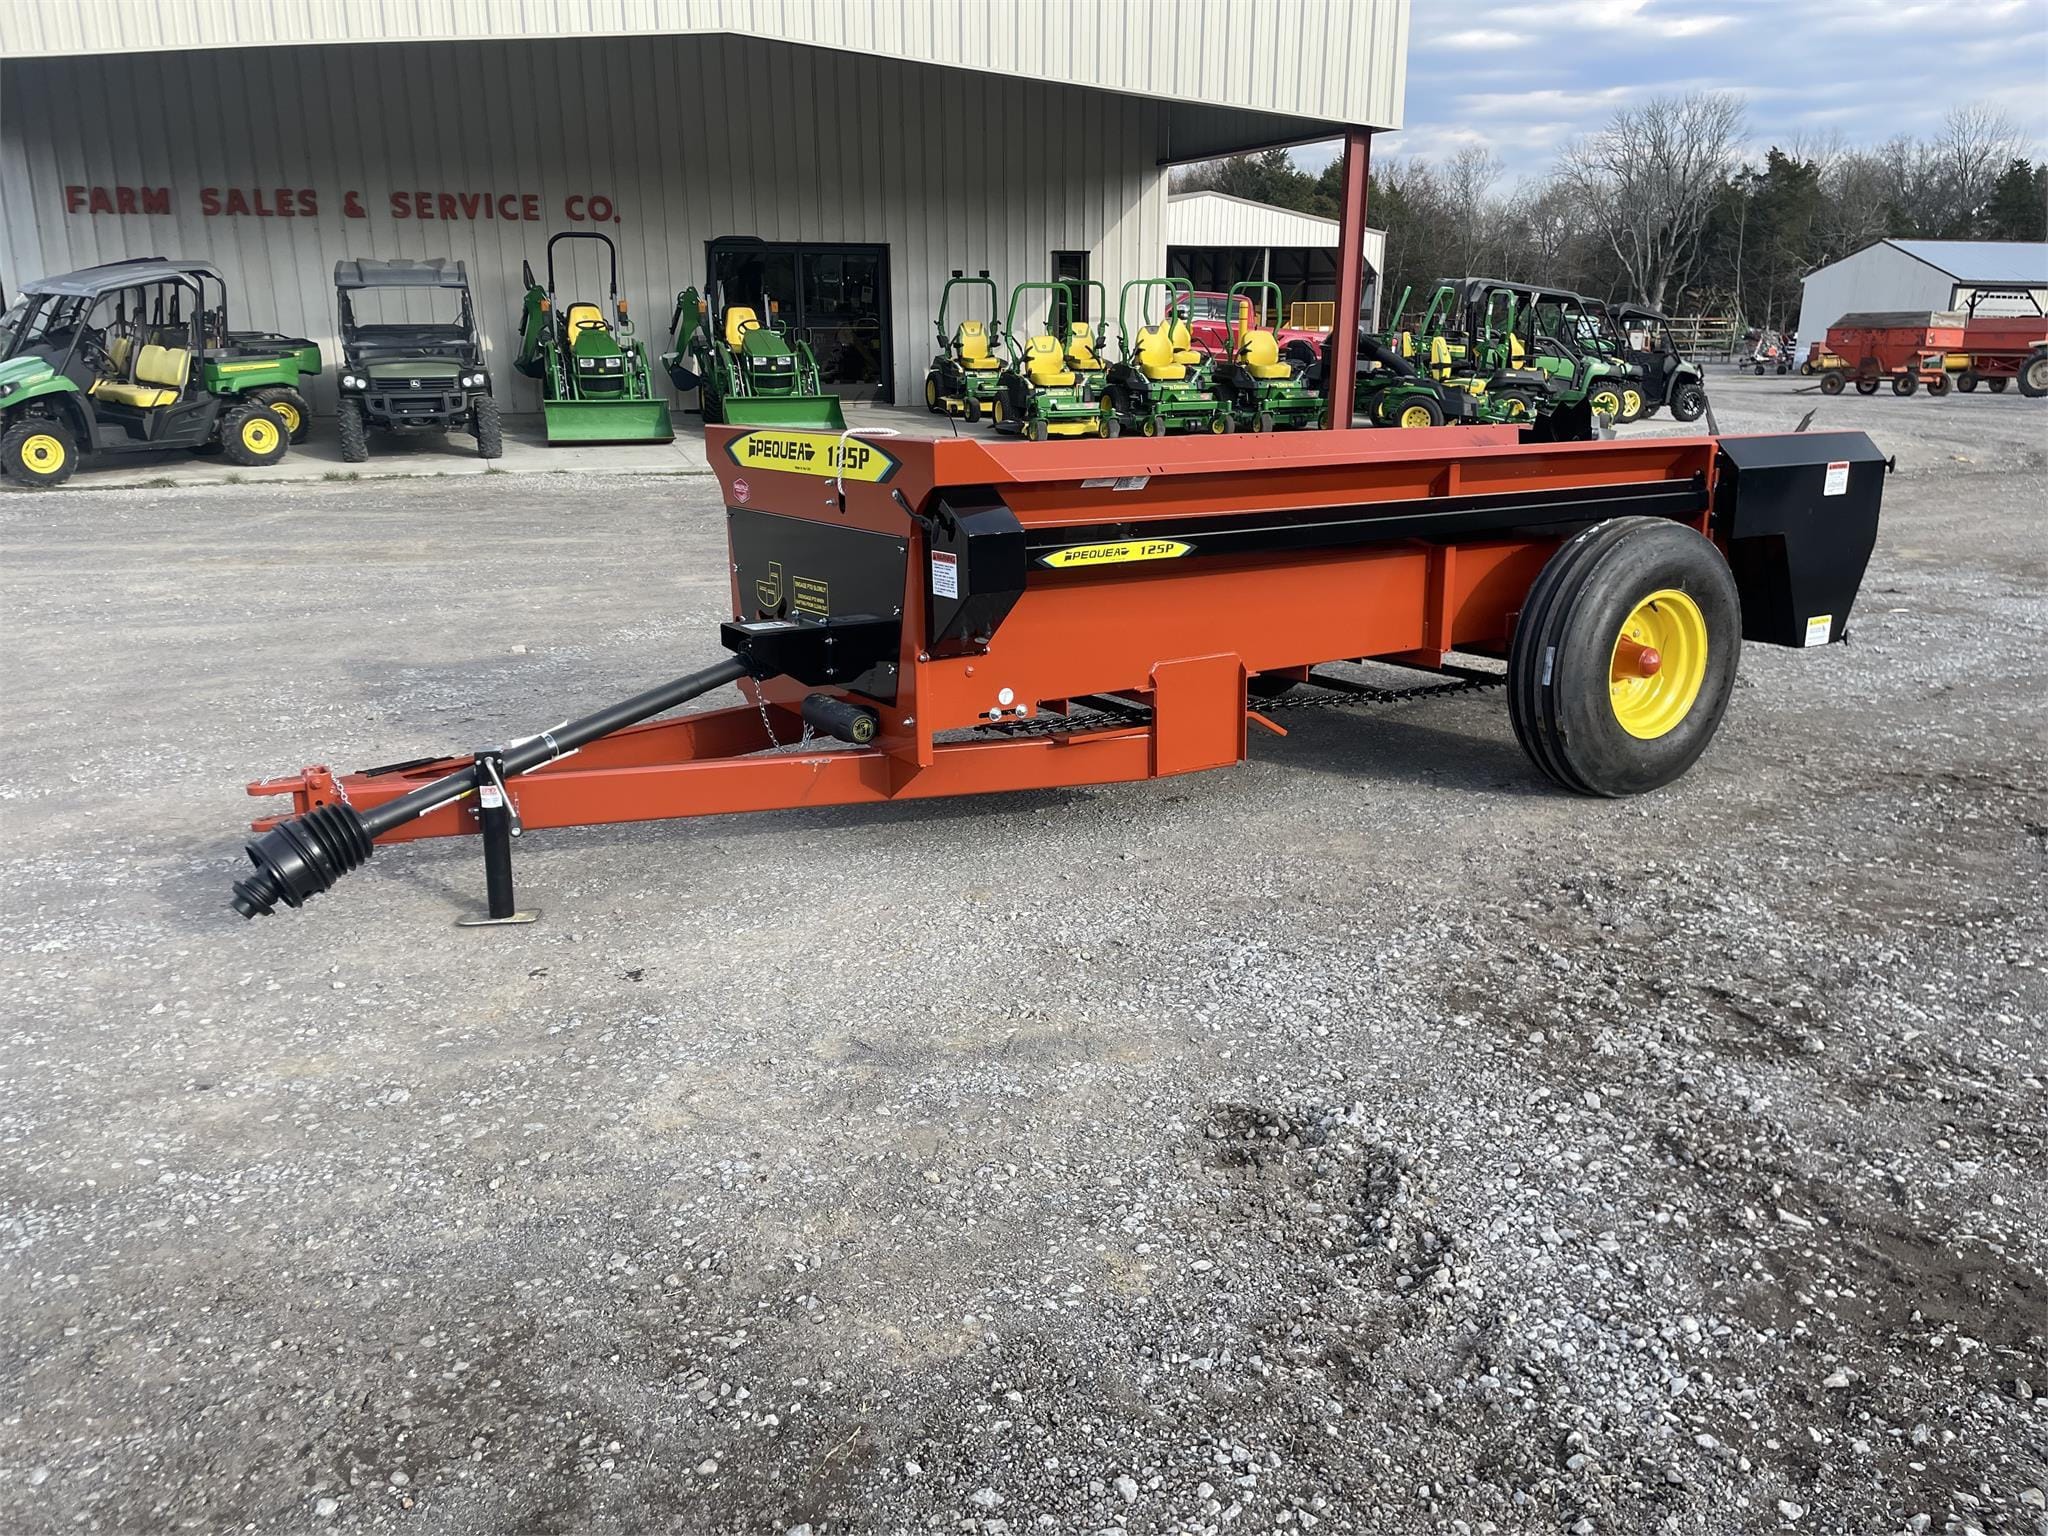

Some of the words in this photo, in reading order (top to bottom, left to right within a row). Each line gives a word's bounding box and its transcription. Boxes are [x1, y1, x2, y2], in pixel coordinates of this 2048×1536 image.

[65, 186, 171, 215] FARM
[200, 188, 318, 217] SALES
[343, 190, 366, 218] &
[390, 191, 540, 222] SERVICE
[565, 195, 621, 224] CO.
[756, 440, 804, 460] PEQUEA
[827, 446, 870, 469] 125P
[1072, 548, 1120, 560] PEQUEA
[1141, 544, 1174, 556] 125P
